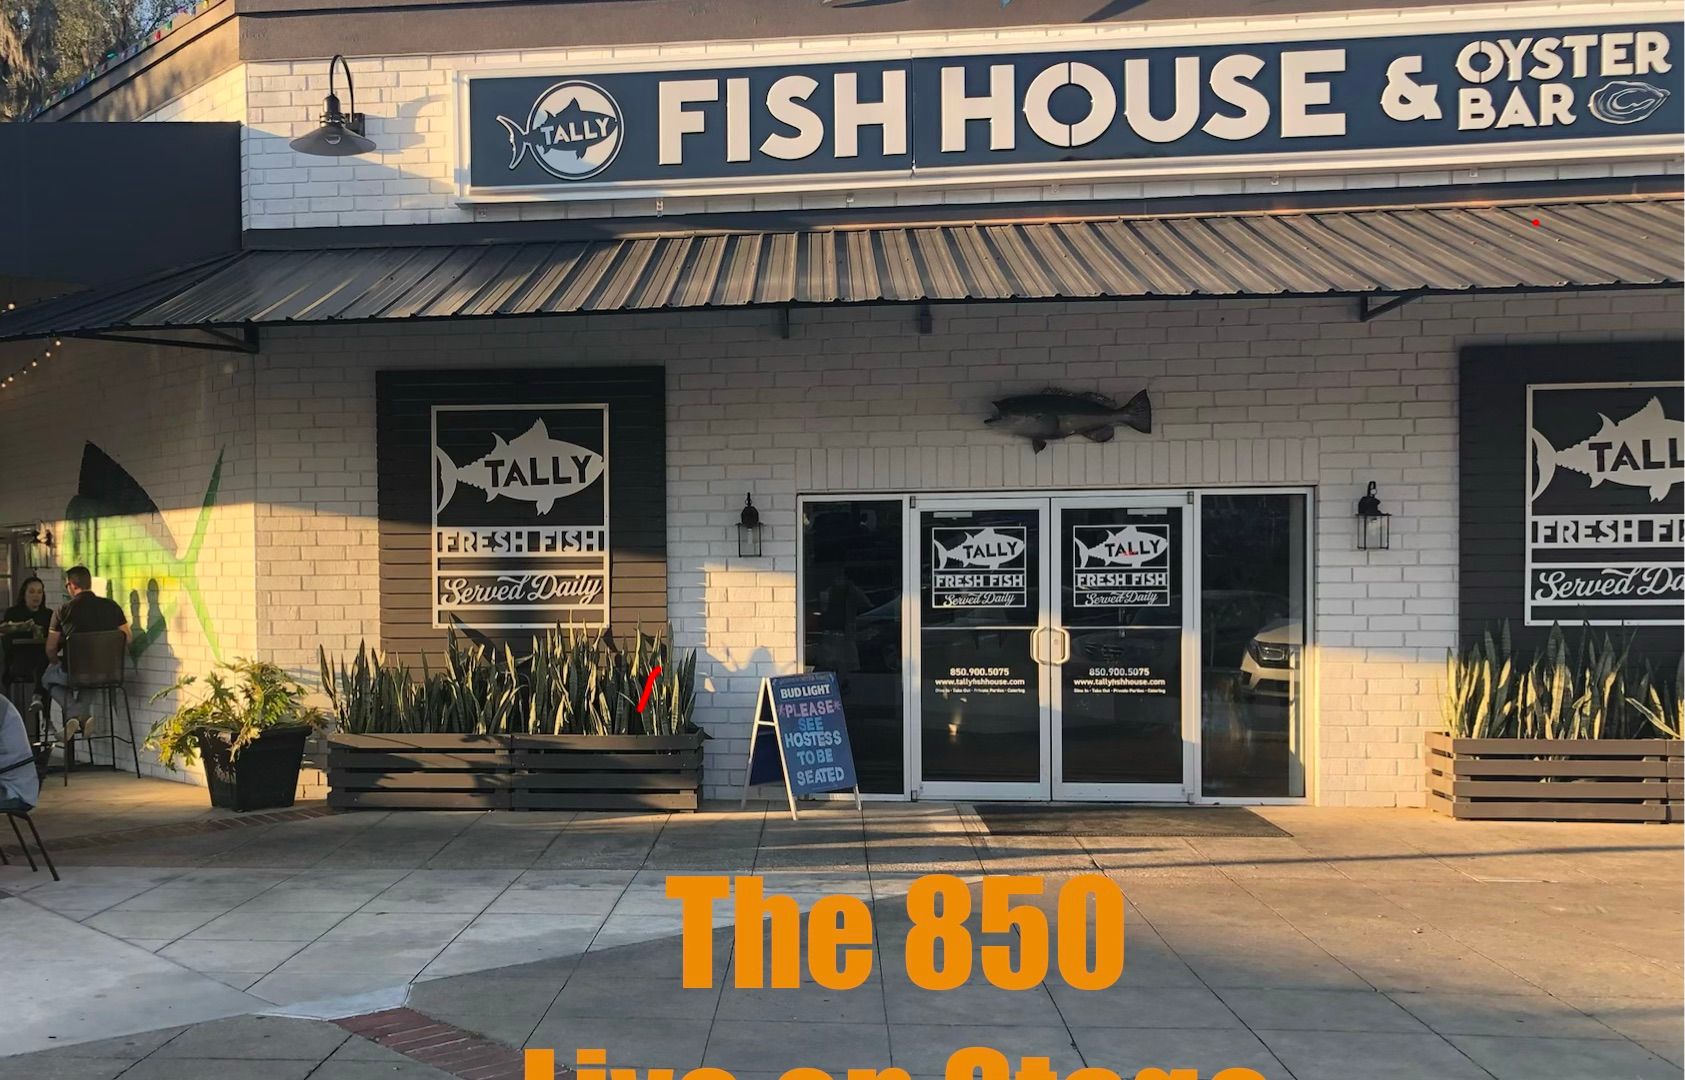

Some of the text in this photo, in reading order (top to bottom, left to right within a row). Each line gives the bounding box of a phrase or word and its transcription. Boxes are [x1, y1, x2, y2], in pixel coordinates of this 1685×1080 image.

[1456, 31, 1672, 84] OYSTER
[658, 48, 1443, 166] FISH HOUSE &
[1458, 83, 1577, 131] BAR
[540, 117, 609, 145] TALLY
[484, 455, 592, 487] TALLY
[1537, 519, 1684, 543] FRESH FI
[442, 531, 599, 552] FRESH FISH
[962, 541, 1018, 559] TALLY
[1104, 539, 1161, 557] TALLY
[936, 574, 1024, 588] FRESH FISH
[1077, 572, 1166, 587] FRESH FISH
[1535, 567, 1642, 601] Served
[441, 573, 602, 605] Served Daily
[1085, 590, 1159, 606] Served Daily
[943, 592, 1015, 607] Served Daily
[949, 667, 1010, 676] 850.900.5075
[1089, 667, 1150, 676] 850.900.5075
[780, 684, 831, 699] BUD LIGHT
[935, 678, 1025, 687] www.tallyfishhouse.com
[1073, 678, 1166, 687] www.tallyfishhouse.com
[785, 700, 834, 718] PLEASE
[798, 717, 824, 731] SEE
[784, 730, 842, 748] HOSTESS
[796, 748, 834, 765] TO BE
[796, 767, 845, 786] SEATED
